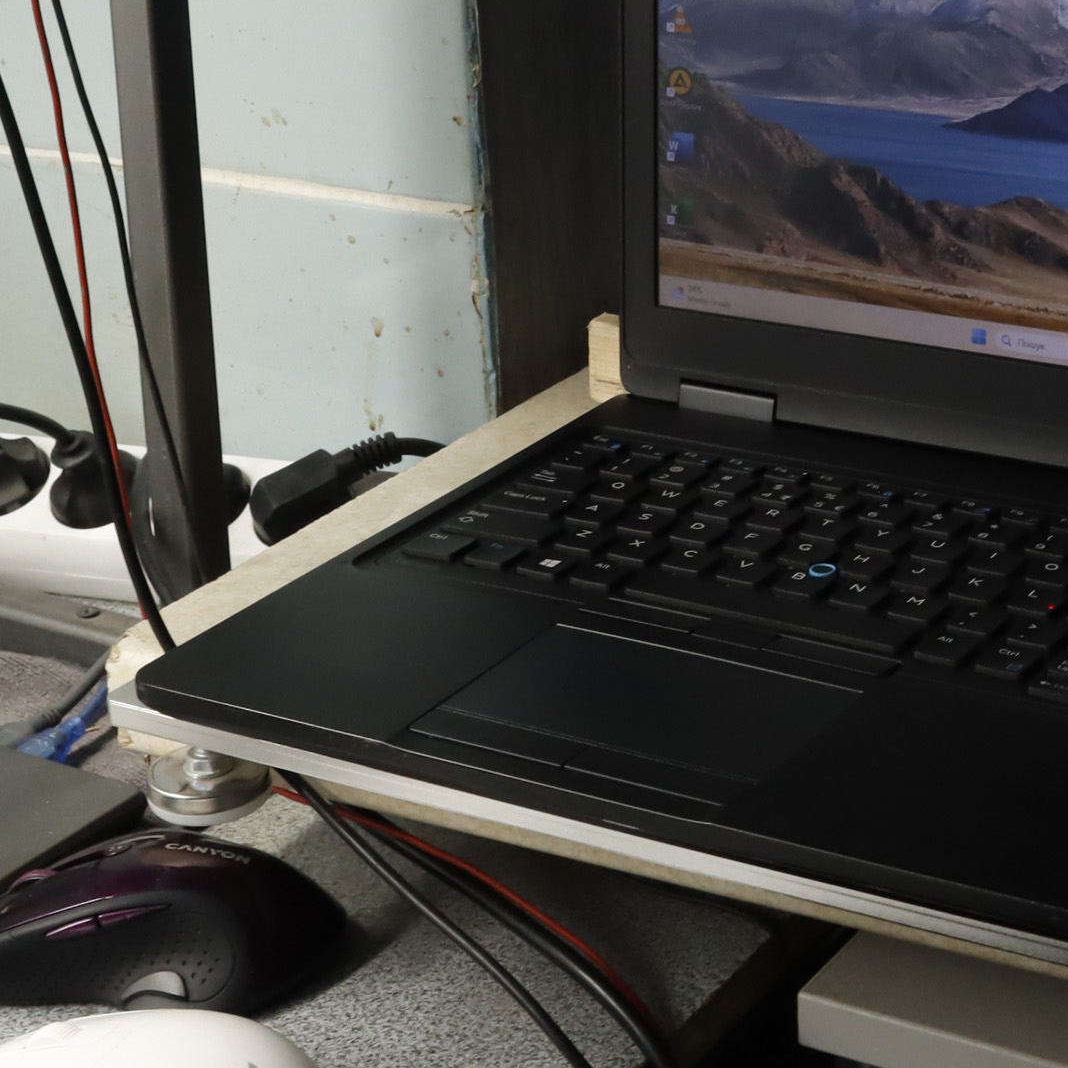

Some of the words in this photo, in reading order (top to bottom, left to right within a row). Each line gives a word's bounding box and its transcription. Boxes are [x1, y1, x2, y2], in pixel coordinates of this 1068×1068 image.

[1017, 338, 1046, 352] Пошук
[661, 489, 682, 499] W
[585, 503, 599, 512] A
[713, 499, 729, 508] E
[638, 513, 653, 521] S
[765, 508, 780, 517] R
[690, 522, 705, 530] D
[822, 518, 835, 526] T
[575, 529, 593, 538] Z
[744, 532, 759, 540] F
[877, 528, 891, 537] Y
[628, 539, 647, 548] X
[799, 543, 813, 552] G
[930, 539, 946, 549] U
[683, 549, 699, 558] C
[853, 554, 870, 563] H
[739, 560, 755, 569] V
[1044, 562, 1060, 571] O
[791, 571, 807, 581] B
[968, 577, 984, 587] K
[848, 582, 868, 593] N
[1027, 589, 1039, 599] L
[906, 596, 927, 606] M
[164, 841, 251, 867] CANYON
